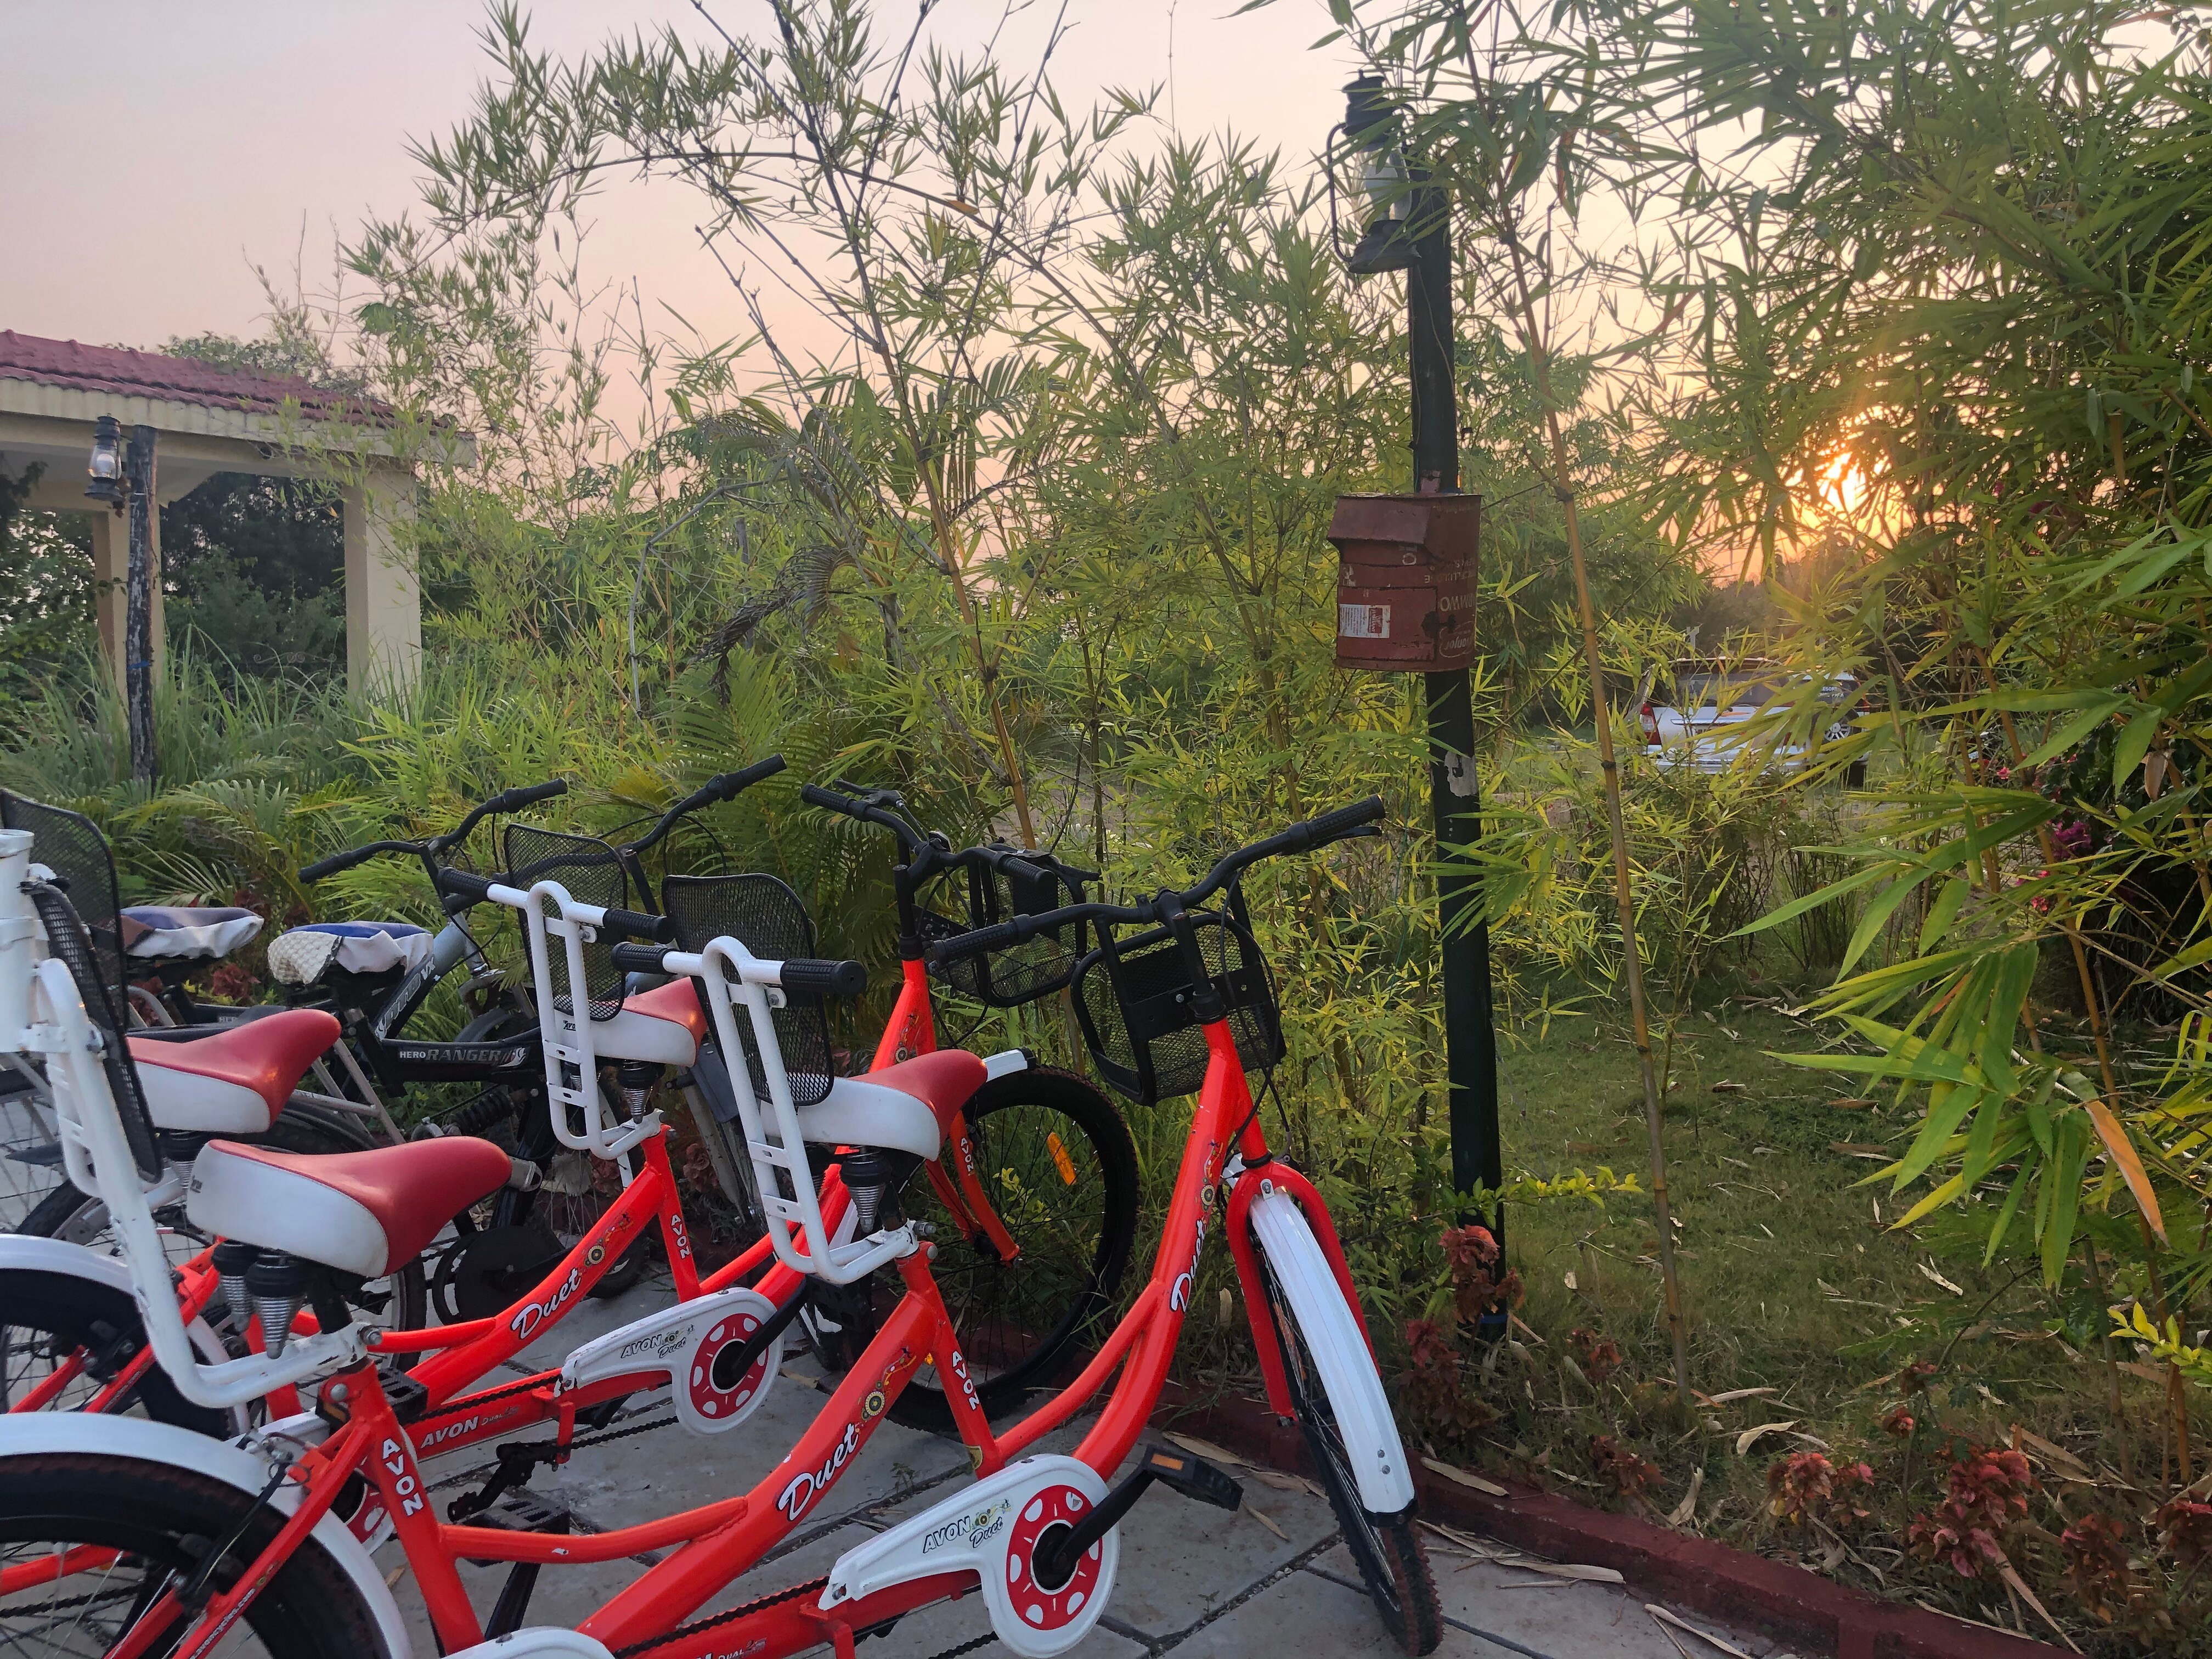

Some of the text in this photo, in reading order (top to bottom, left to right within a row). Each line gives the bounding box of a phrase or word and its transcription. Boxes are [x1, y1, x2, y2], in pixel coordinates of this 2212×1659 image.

[420, 957, 436, 980] VX
[563, 1020, 576, 1031] AVO
[426, 1049, 501, 1061] RANGER
[961, 1137, 974, 1172] AVON
[671, 1214, 690, 1259] AVON
[1170, 1220, 1206, 1313] Duet
[510, 1268, 582, 1339] Duet
[620, 1334, 662, 1358] AVON
[658, 1337, 686, 1358] Duet
[952, 1351, 979, 1410] AVON
[420, 1416, 479, 1449] AVON
[383, 1438, 424, 1516] AVON
[776, 1423, 859, 1521] Duet
[923, 1515, 970, 1554] AVON
[969, 1516, 1003, 1548] Duet
